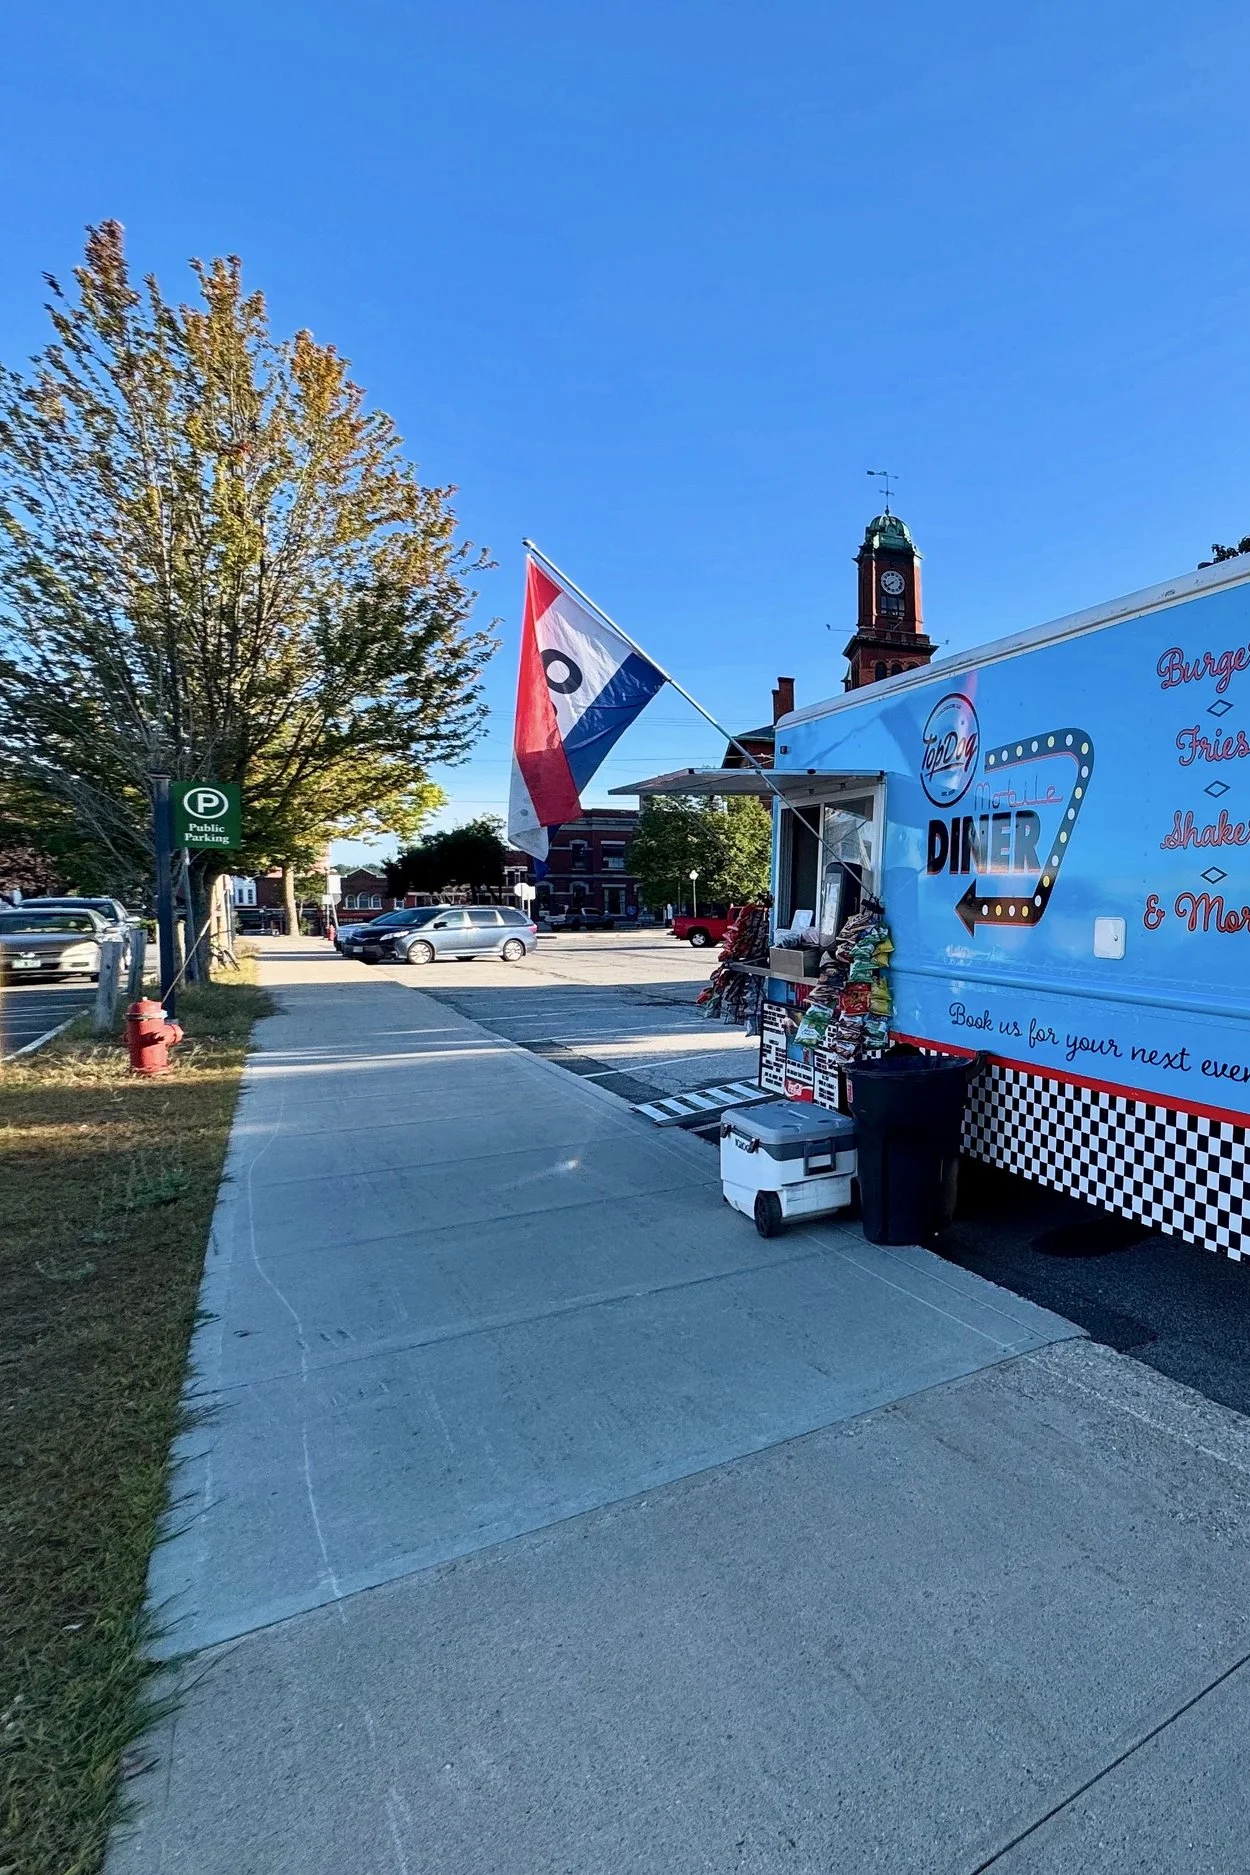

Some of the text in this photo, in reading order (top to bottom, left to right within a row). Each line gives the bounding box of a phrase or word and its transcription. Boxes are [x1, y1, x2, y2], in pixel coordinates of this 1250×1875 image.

[974, 774, 1064, 811] Mobile
[184, 832, 230, 845] Parking
[188, 823, 225, 833] Public
[927, 810, 1041, 875] DINER
[1144, 893, 1165, 930] &
[949, 1002, 993, 1032] Book
[999, 1021, 1023, 1037] us
[1028, 1018, 1060, 1049] for
[1066, 1033, 1122, 1061] your
[1131, 1046, 1192, 1072] next
